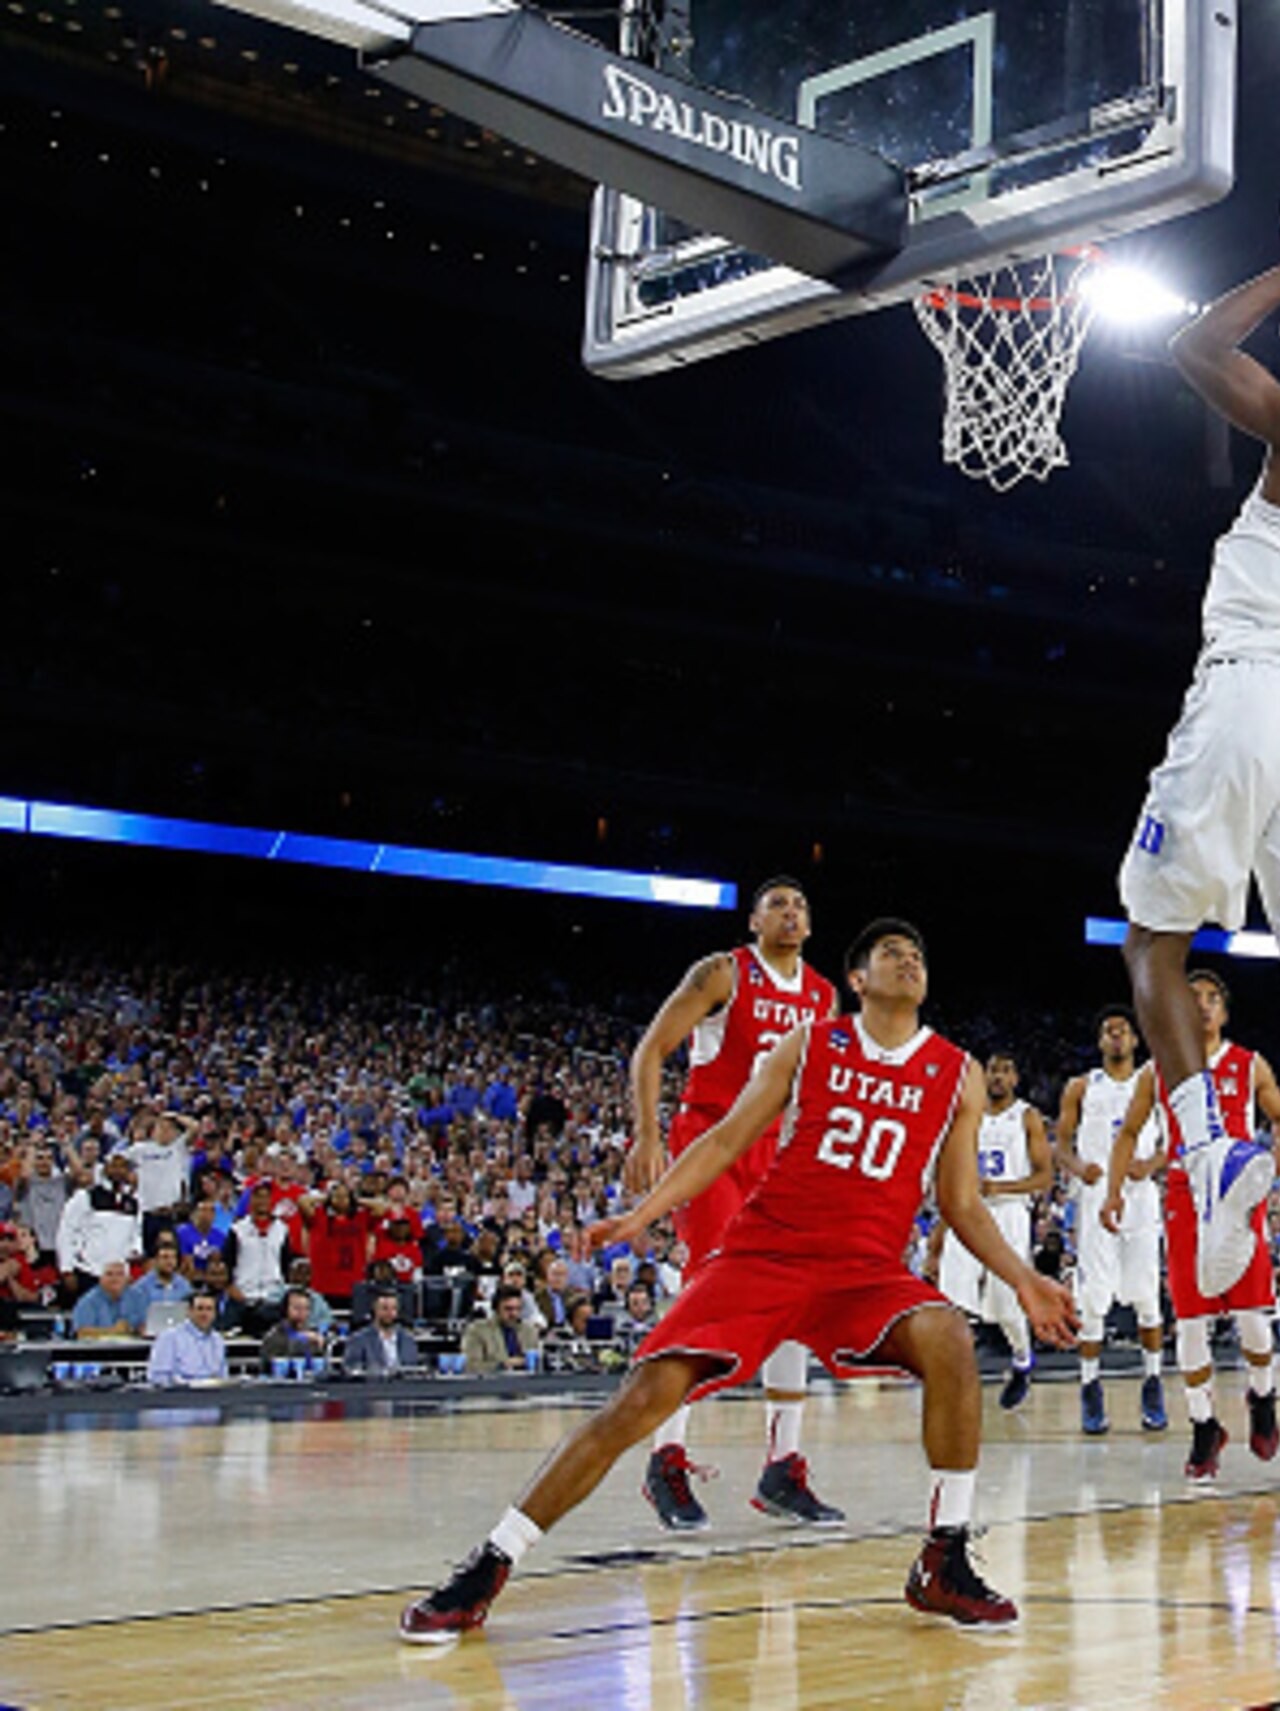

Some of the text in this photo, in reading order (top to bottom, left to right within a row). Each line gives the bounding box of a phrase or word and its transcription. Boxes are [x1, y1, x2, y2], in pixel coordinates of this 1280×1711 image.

[602, 64, 802, 191] SPALDING
[753, 997, 816, 1027] UTAH
[828, 1064, 924, 1113] UTAH
[816, 1105, 907, 1181] 20
